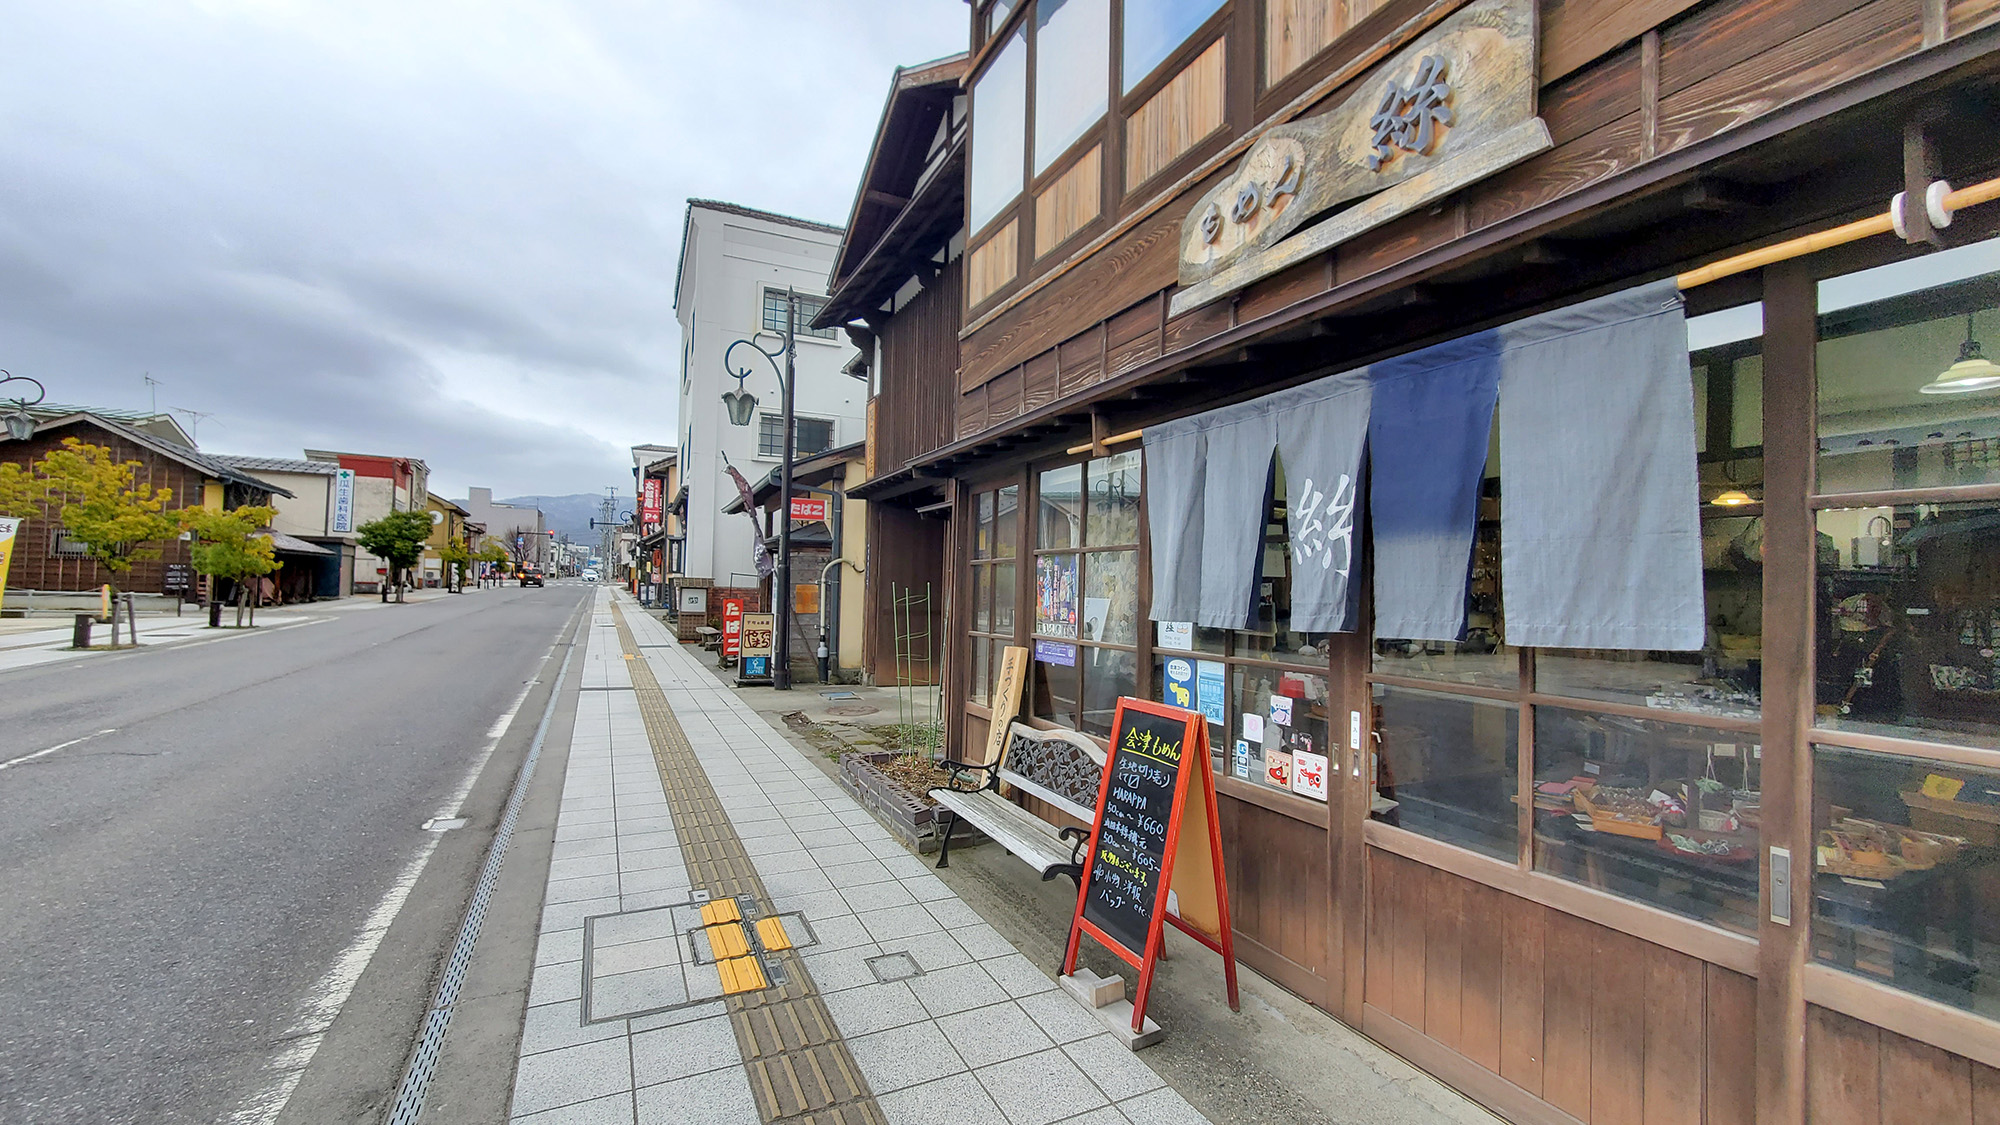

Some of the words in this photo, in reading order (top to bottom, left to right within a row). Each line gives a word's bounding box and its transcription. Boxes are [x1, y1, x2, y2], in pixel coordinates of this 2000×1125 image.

[336, 480, 349, 530] 瓜生歯科医院
[791, 503, 823, 516] たばこ
[1125, 726, 1181, 762] 会津もめん
[1113, 786, 1147, 810] HARAPPA
[1099, 889, 1126, 909] バッグ
